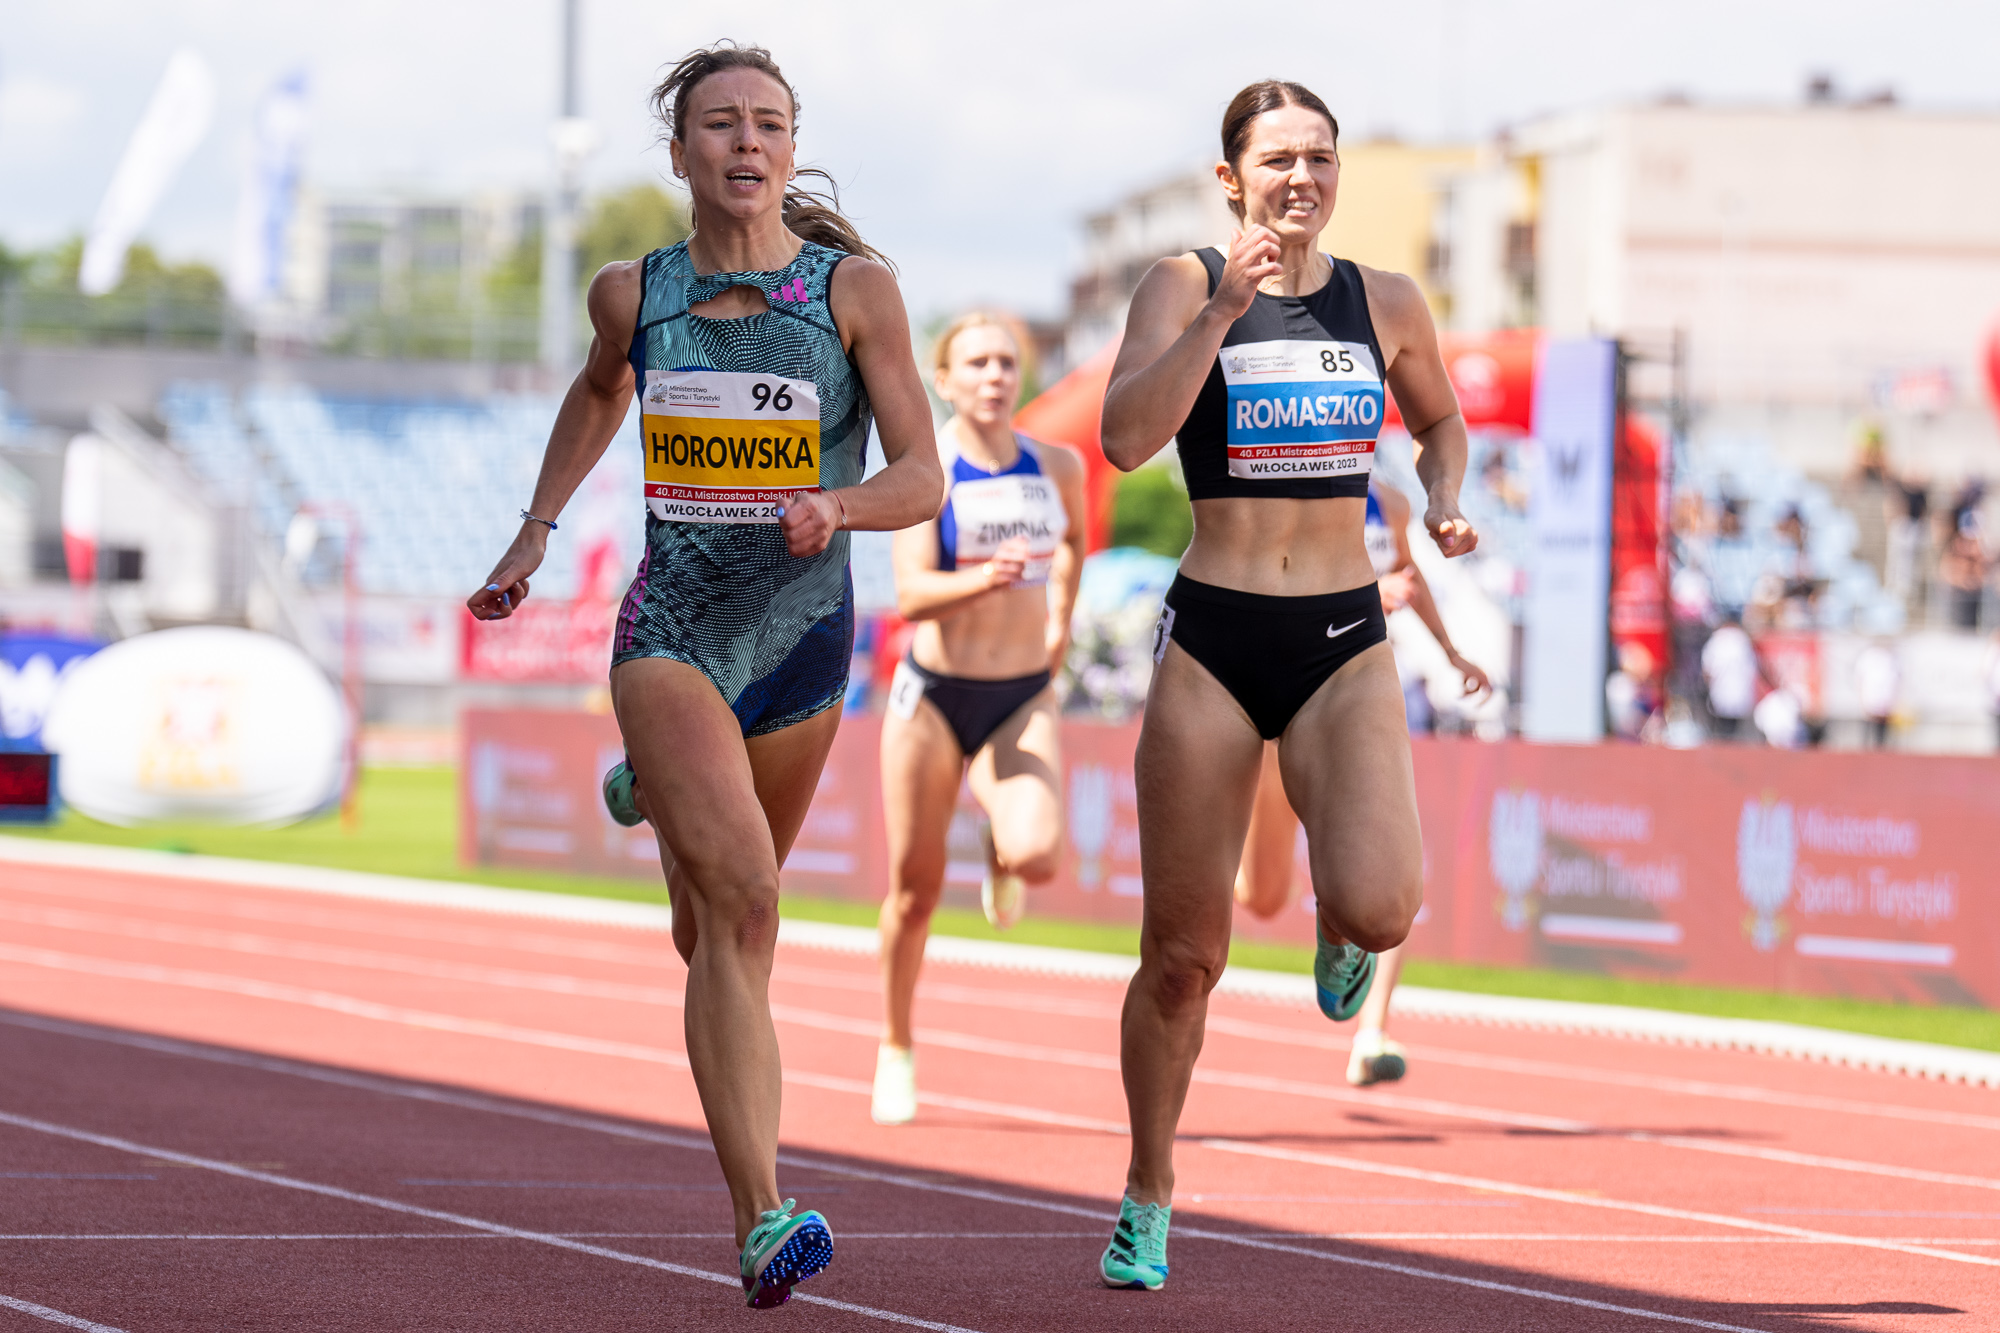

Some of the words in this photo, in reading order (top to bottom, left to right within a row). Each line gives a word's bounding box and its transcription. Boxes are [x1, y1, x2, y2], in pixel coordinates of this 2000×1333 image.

[1320, 350, 1354, 373] 85
[669, 385, 708, 393] Ministerstwo
[669, 393, 688, 401] Sportu
[693, 394, 720, 402] Turystyki
[751, 382, 793, 412] 96
[1236, 394, 1377, 430] ROMASZKO
[651, 432, 814, 469] HOROWSKA
[1239, 449, 1254, 458] 40.
[1256, 448, 1278, 457] PZLA
[1280, 446, 1332, 456] Mistrzostwa
[1333, 444, 1351, 453] Polski
[1352, 443, 1367, 452] U23
[1249, 460, 1335, 473] WŁOCŁAWEK
[1337, 458, 1357, 468] 2023
[655, 487, 671, 496] 40.
[672, 488, 693, 499] PZLA
[694, 490, 755, 501] Mistrzostwa
[757, 491, 787, 500] Polski
[665, 503, 758, 517] WŁOCŁAWEK
[761, 506, 777, 517] 20
